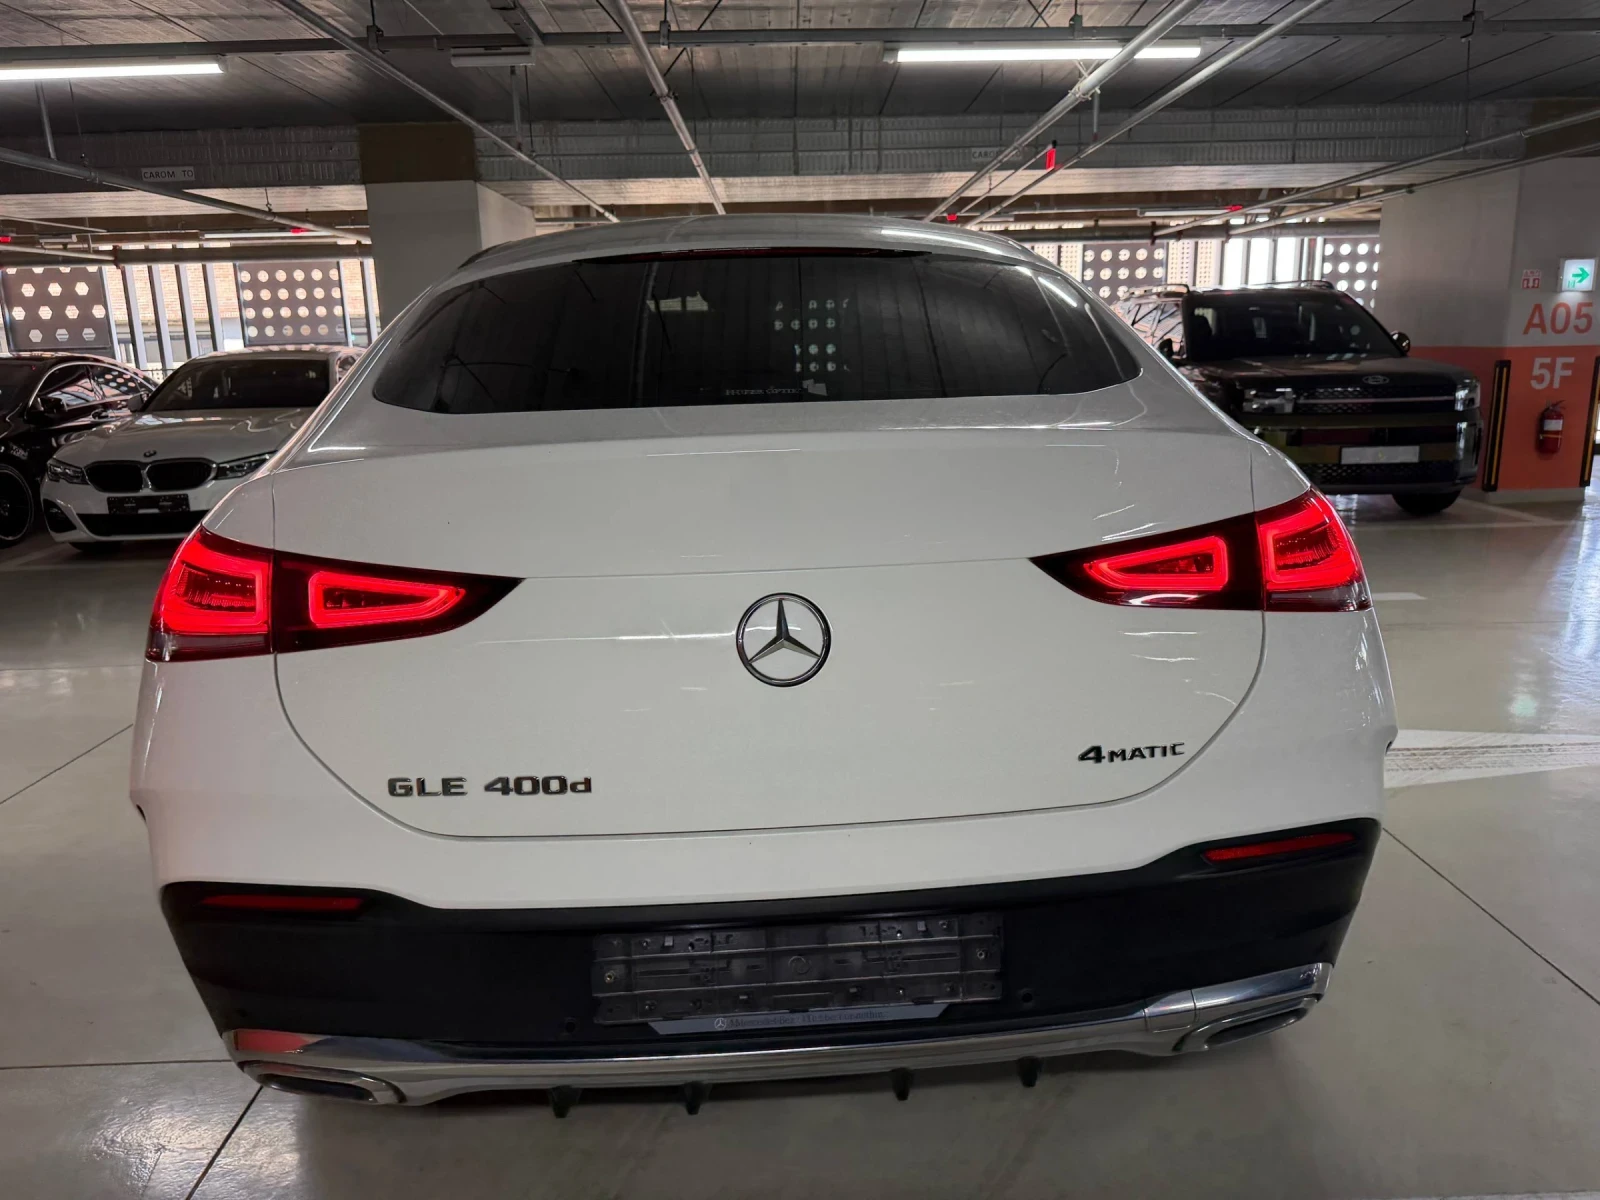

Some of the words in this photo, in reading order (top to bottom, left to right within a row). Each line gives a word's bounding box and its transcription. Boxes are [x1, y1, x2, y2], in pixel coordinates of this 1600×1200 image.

[143, 170, 176, 179] CAROM
[181, 169, 194, 178] TO
[1522, 302, 1593, 335] A05
[1530, 357, 1575, 390] 5F
[1078, 742, 1185, 764] 4MATIC
[387, 777, 469, 797] GLE
[484, 775, 592, 796] 400d
